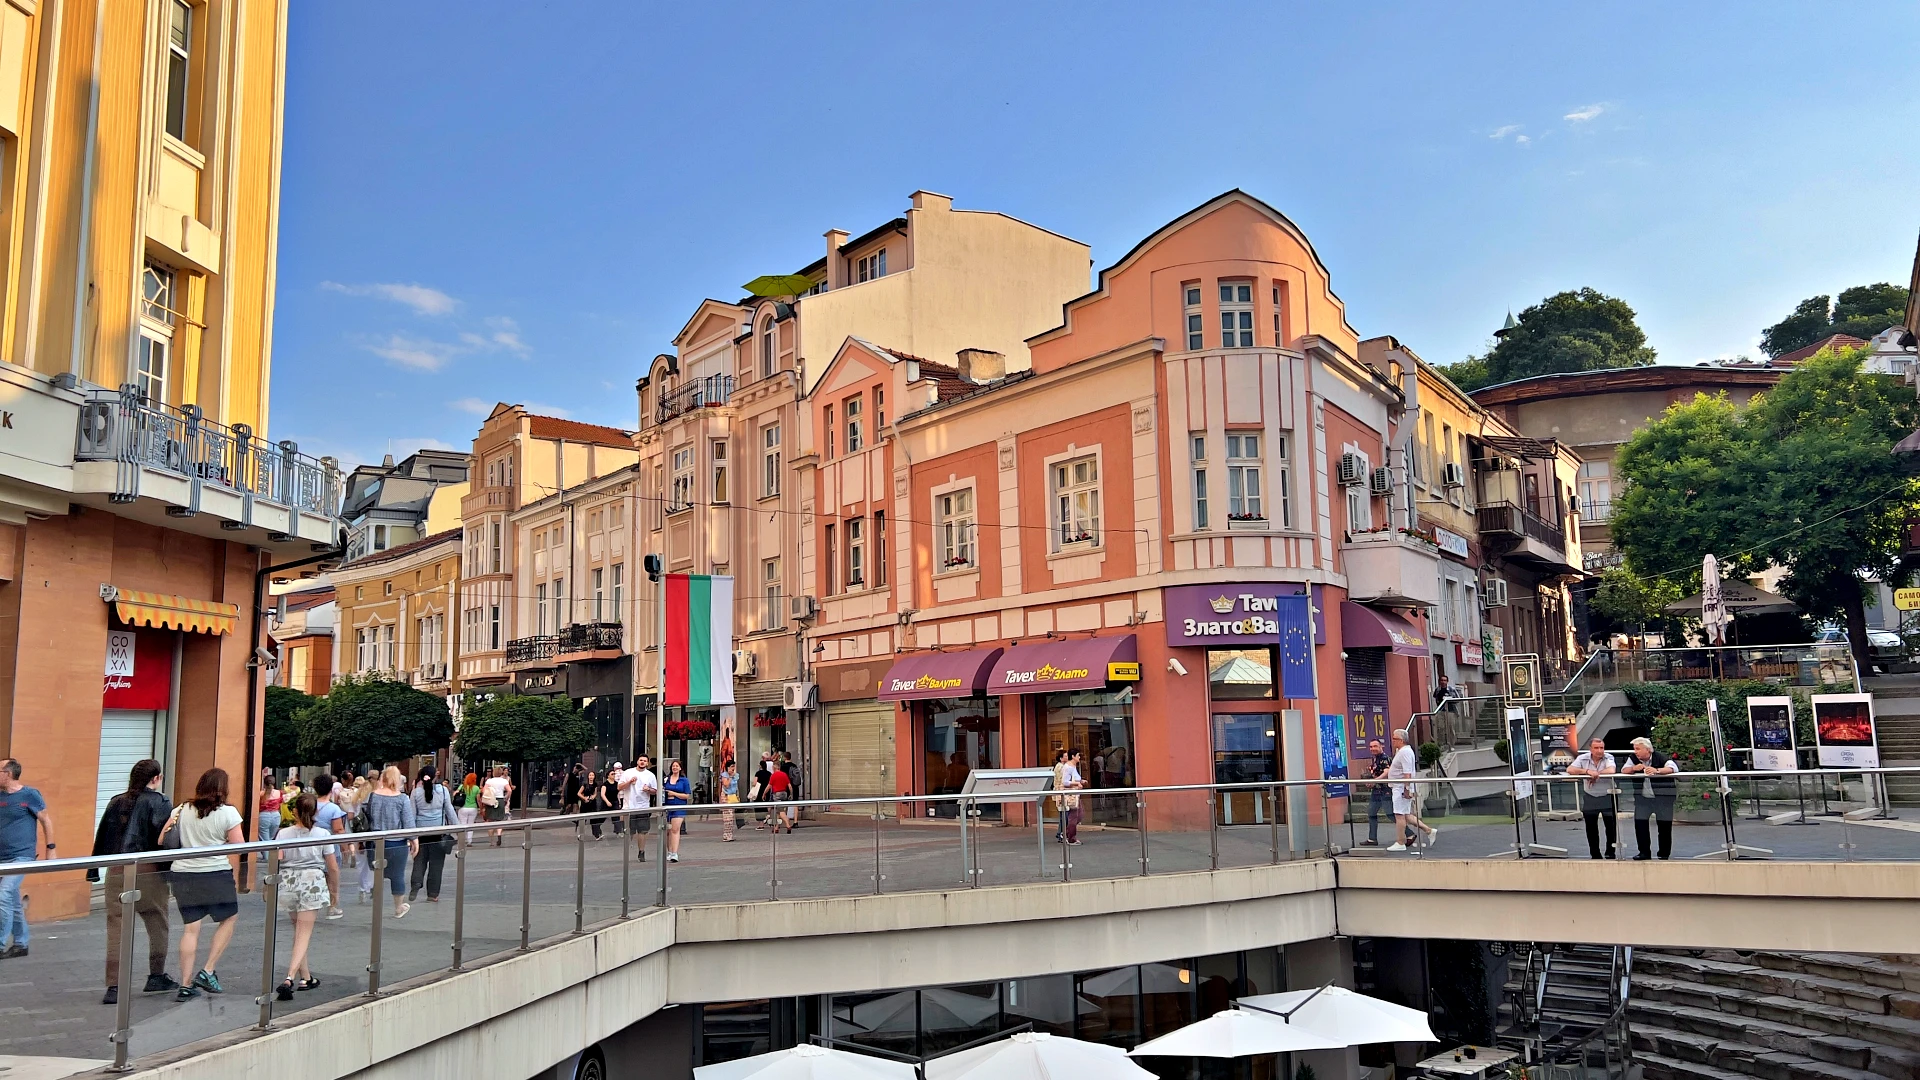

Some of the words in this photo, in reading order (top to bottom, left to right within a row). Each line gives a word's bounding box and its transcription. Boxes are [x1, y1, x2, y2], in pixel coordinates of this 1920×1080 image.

[1239, 594, 1277, 612] Tav
[1908, 600, 1920, 608] БИ
[103, 672, 132, 694] Fashion
[1004, 670, 1036, 684] Tavex
[1052, 667, 1089, 680] Злато
[890, 678, 916, 692] Tavex
[928, 678, 962, 690] Валута
[1354, 714, 1366, 737] 12
